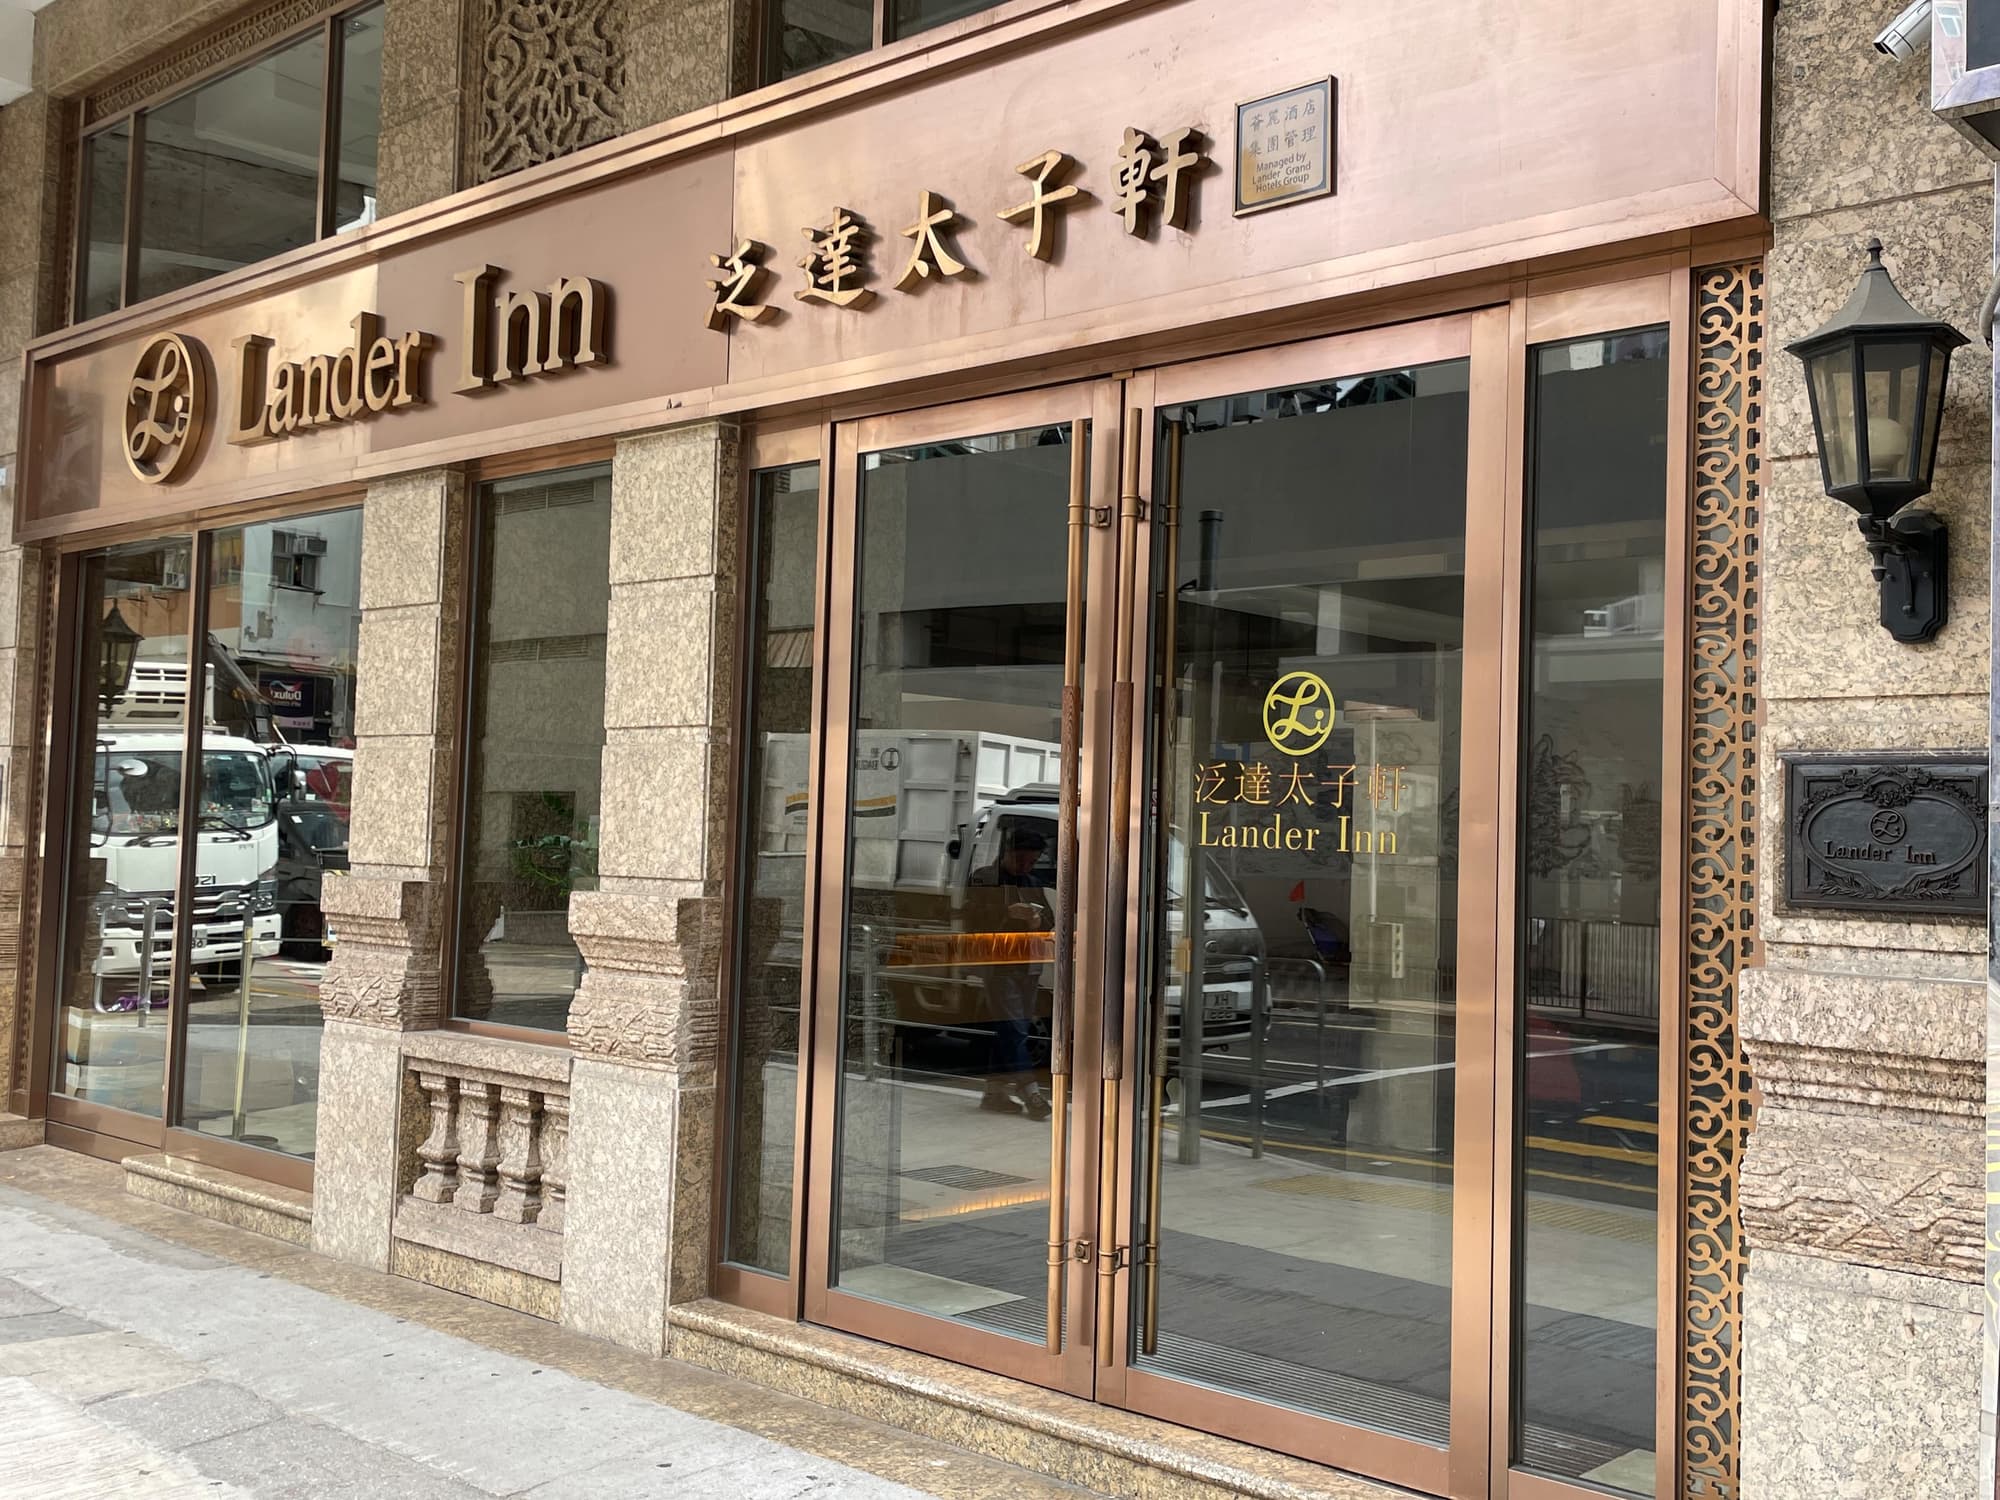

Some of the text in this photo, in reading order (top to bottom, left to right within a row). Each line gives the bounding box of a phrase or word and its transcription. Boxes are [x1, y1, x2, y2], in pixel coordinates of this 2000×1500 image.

[1249, 125, 1318, 158] 集團管理
[1252, 161, 1312, 185] Lander Grand
[1256, 151, 1307, 173] Managed by
[1255, 173, 1310, 193] Hotels Group
[704, 127, 1210, 330] 泛達太子軒
[228, 263, 612, 446] Lander Inn
[1194, 761, 1408, 811] 泛達太子軒
[1198, 811, 1398, 854] Lander Inn
[1823, 839, 1937, 864] Lander Inn
